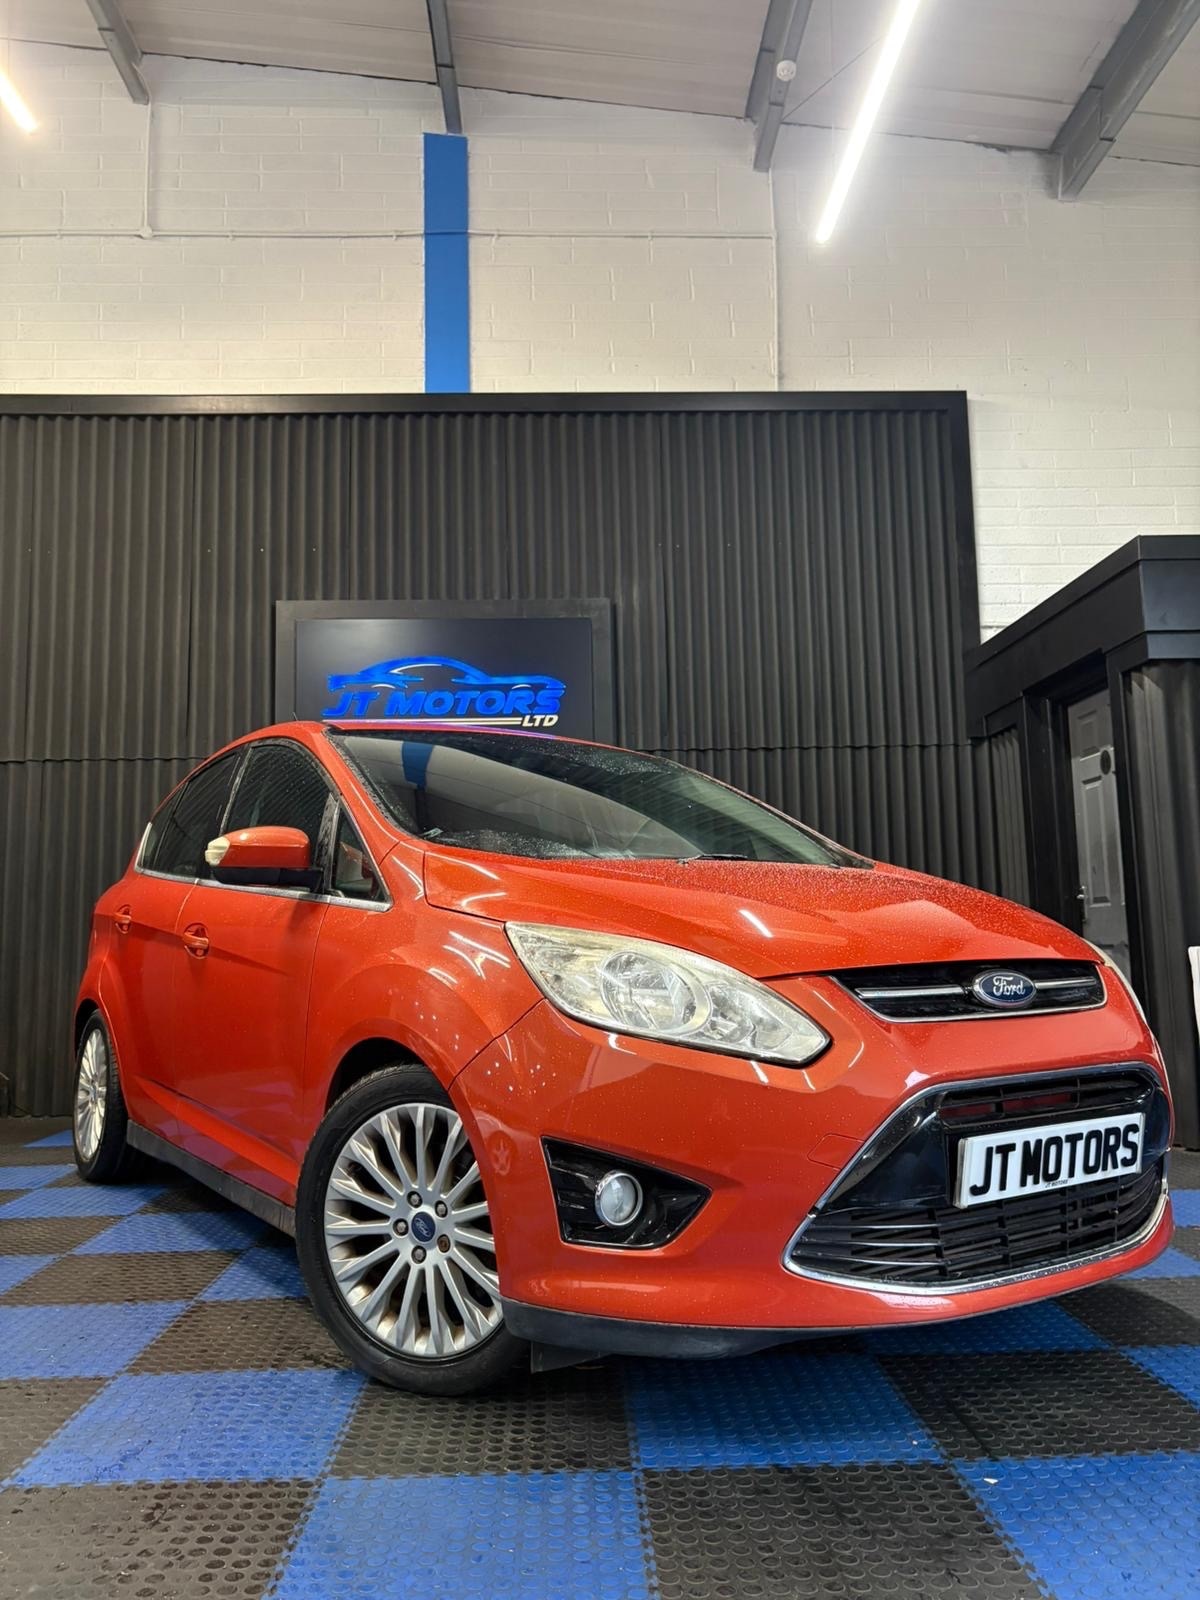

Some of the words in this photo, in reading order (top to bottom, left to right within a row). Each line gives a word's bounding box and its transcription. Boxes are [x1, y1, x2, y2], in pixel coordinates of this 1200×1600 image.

[321, 691, 379, 716] JT
[385, 690, 565, 715] MOTORS
[522, 715, 559, 727] LTD
[993, 976, 1025, 996] Ford
[969, 1143, 1016, 1196] JT
[1020, 1124, 1139, 1187] MOTORS
